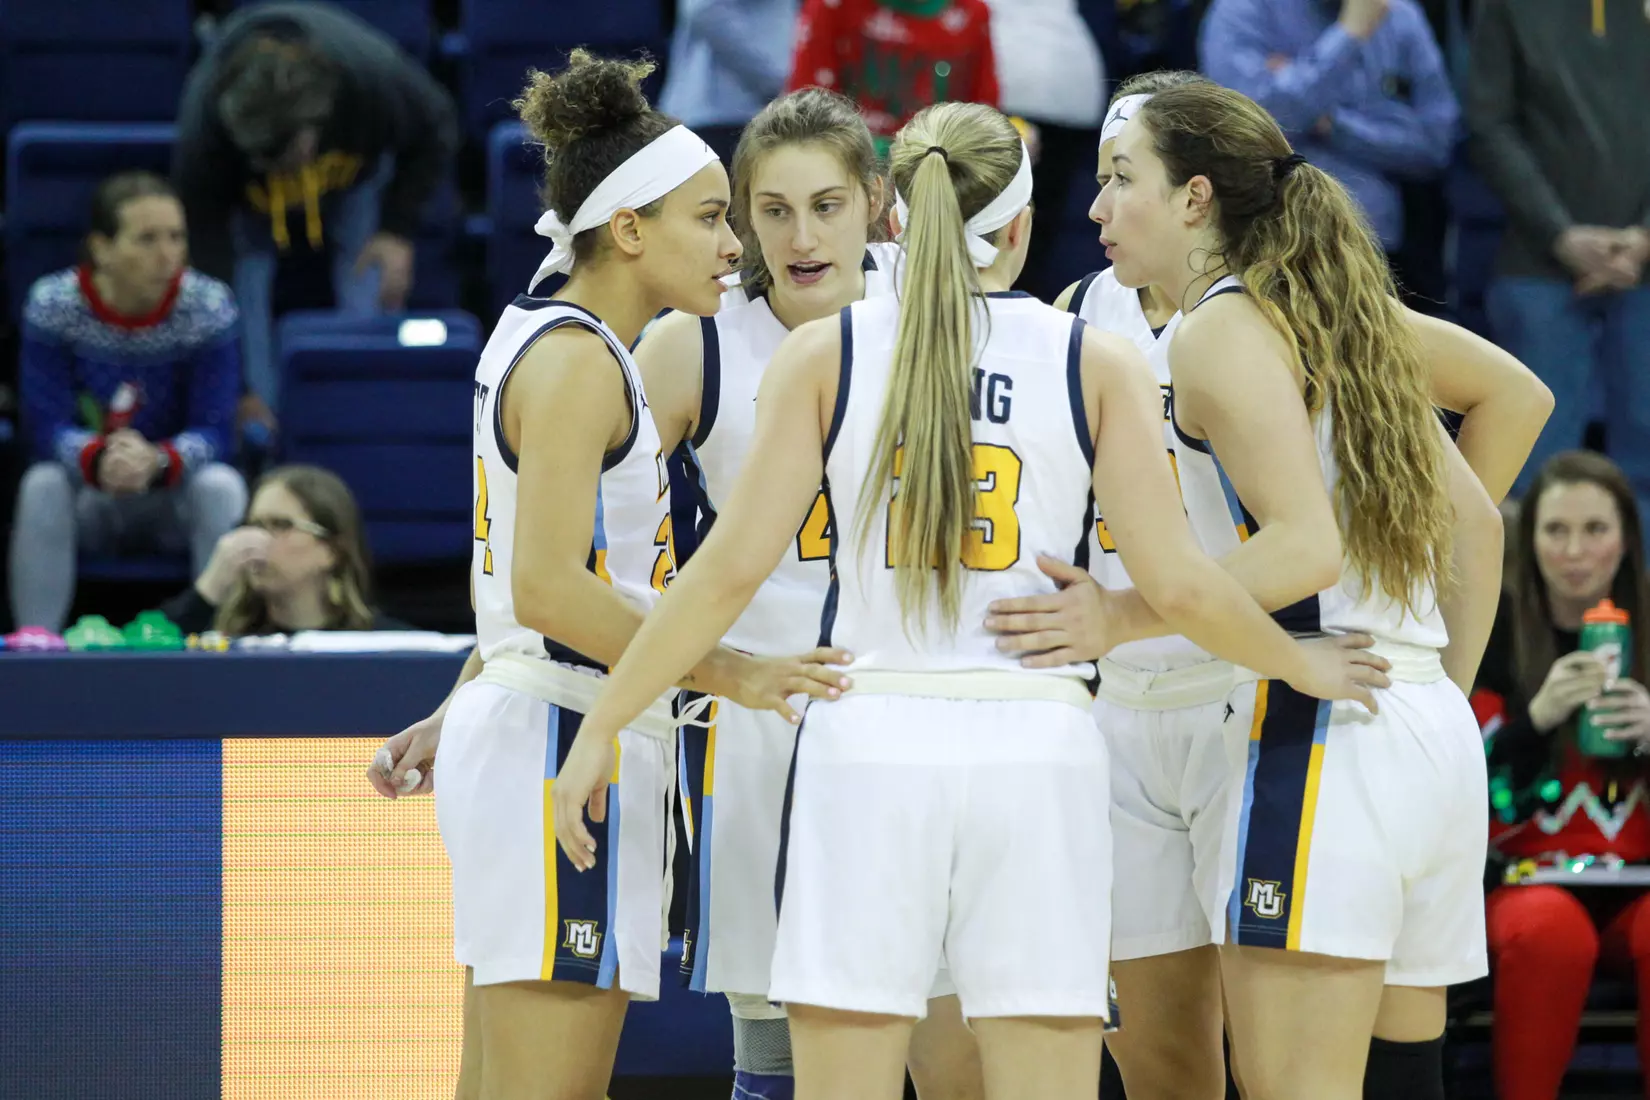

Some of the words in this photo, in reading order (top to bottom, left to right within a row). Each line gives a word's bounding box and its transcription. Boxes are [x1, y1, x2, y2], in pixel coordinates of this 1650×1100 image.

[885, 442, 1023, 571] 3
[1245, 878, 1285, 918] MU
[564, 920, 601, 958] MU
